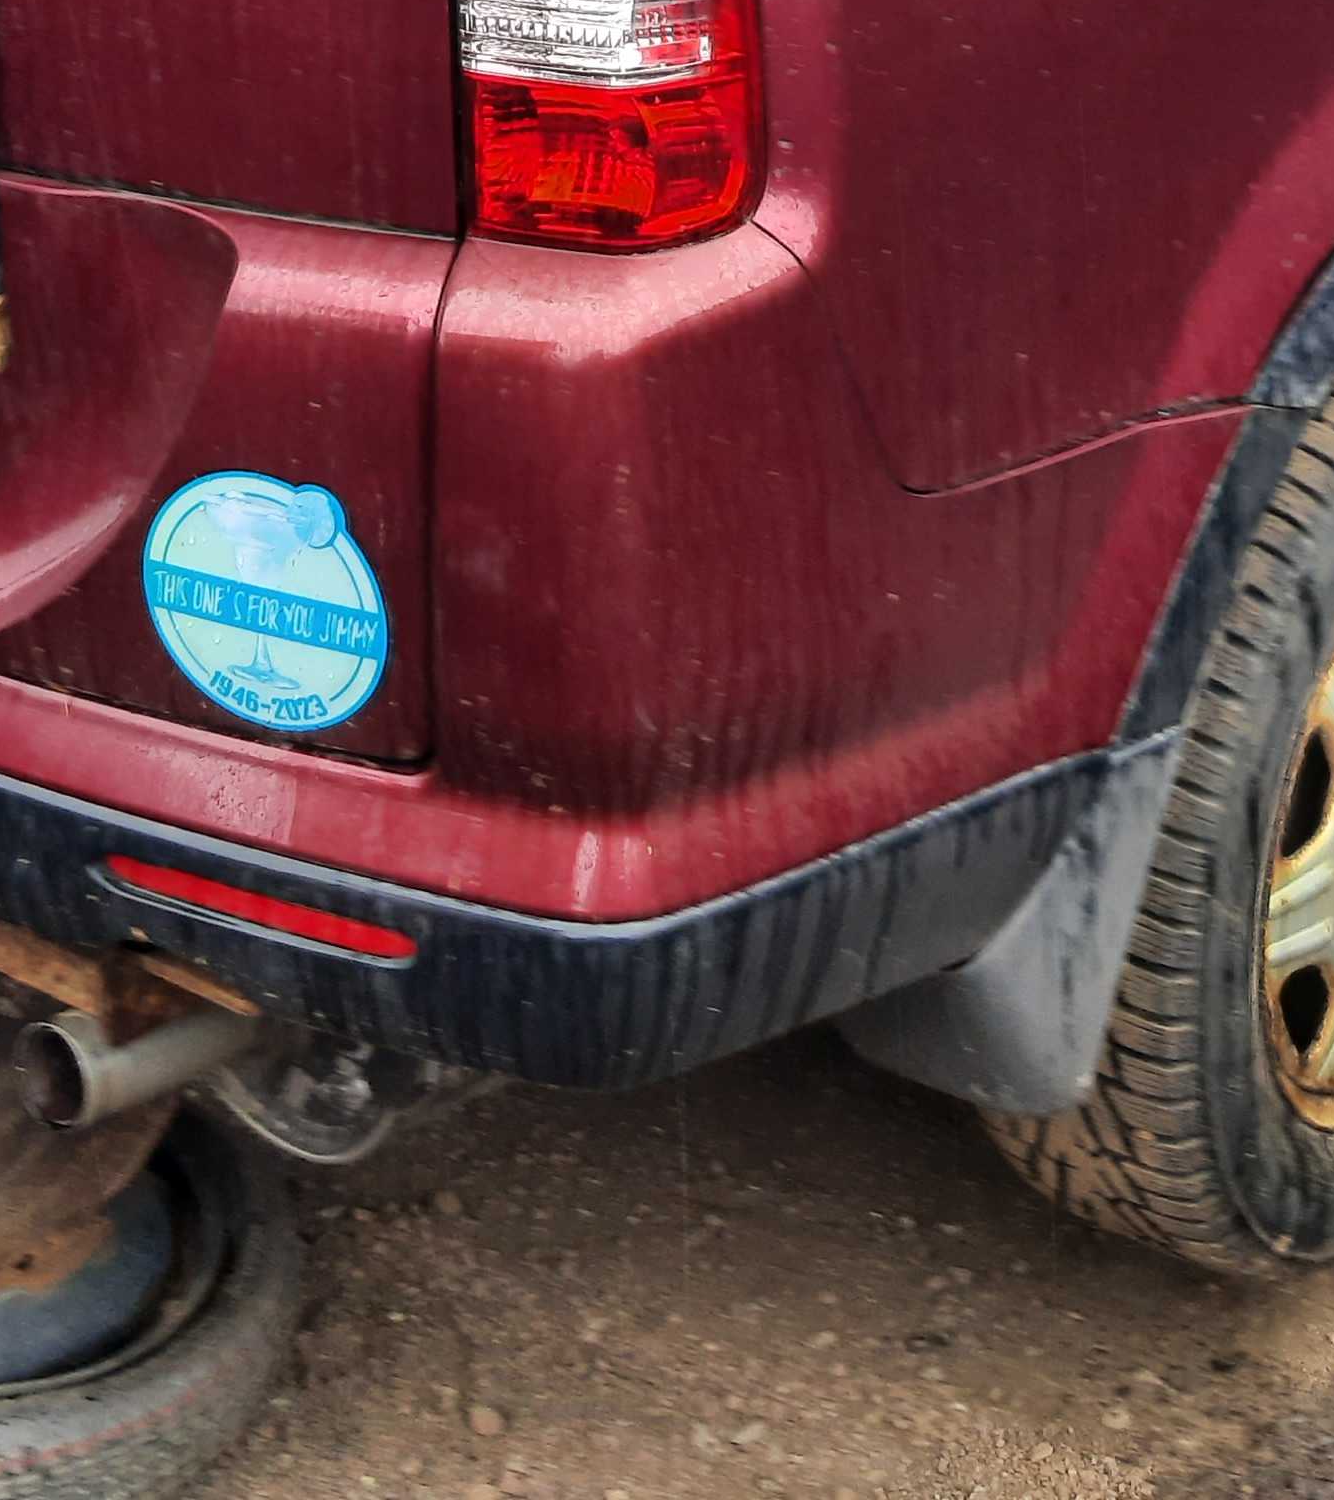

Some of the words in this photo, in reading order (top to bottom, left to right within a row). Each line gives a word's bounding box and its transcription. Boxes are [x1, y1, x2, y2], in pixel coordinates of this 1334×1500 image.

[155, 570, 191, 607] THIS
[247, 594, 279, 631] FOR
[283, 601, 316, 637] YOU
[319, 611, 379, 649] JIMMY
[210, 670, 329, 720] 1946-2023
